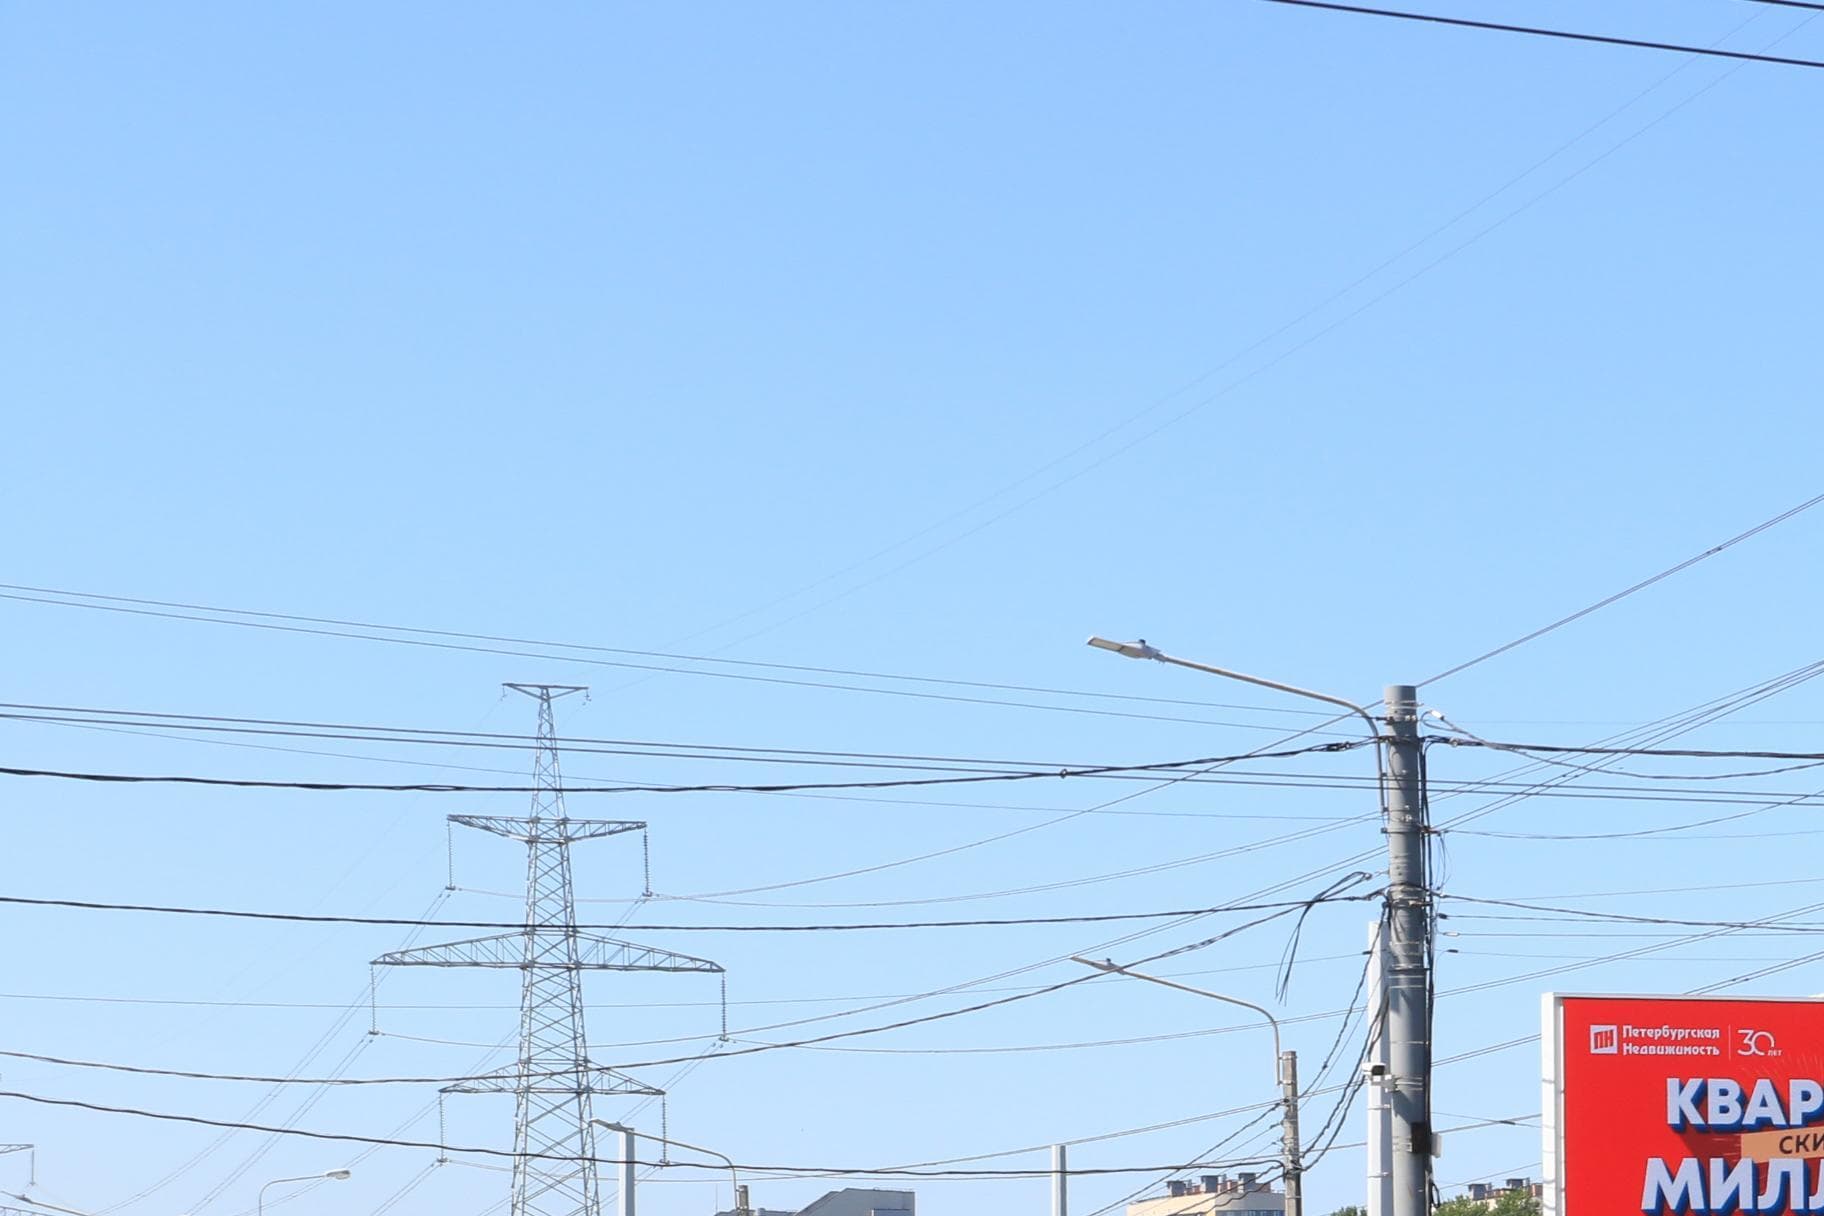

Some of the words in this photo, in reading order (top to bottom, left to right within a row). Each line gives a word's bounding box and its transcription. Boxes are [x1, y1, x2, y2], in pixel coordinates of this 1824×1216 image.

[1622, 1025, 1720, 1040] Петербургская
[1622, 1042, 1720, 1056] Недвижимость
[1737, 1029, 1775, 1056] 30
